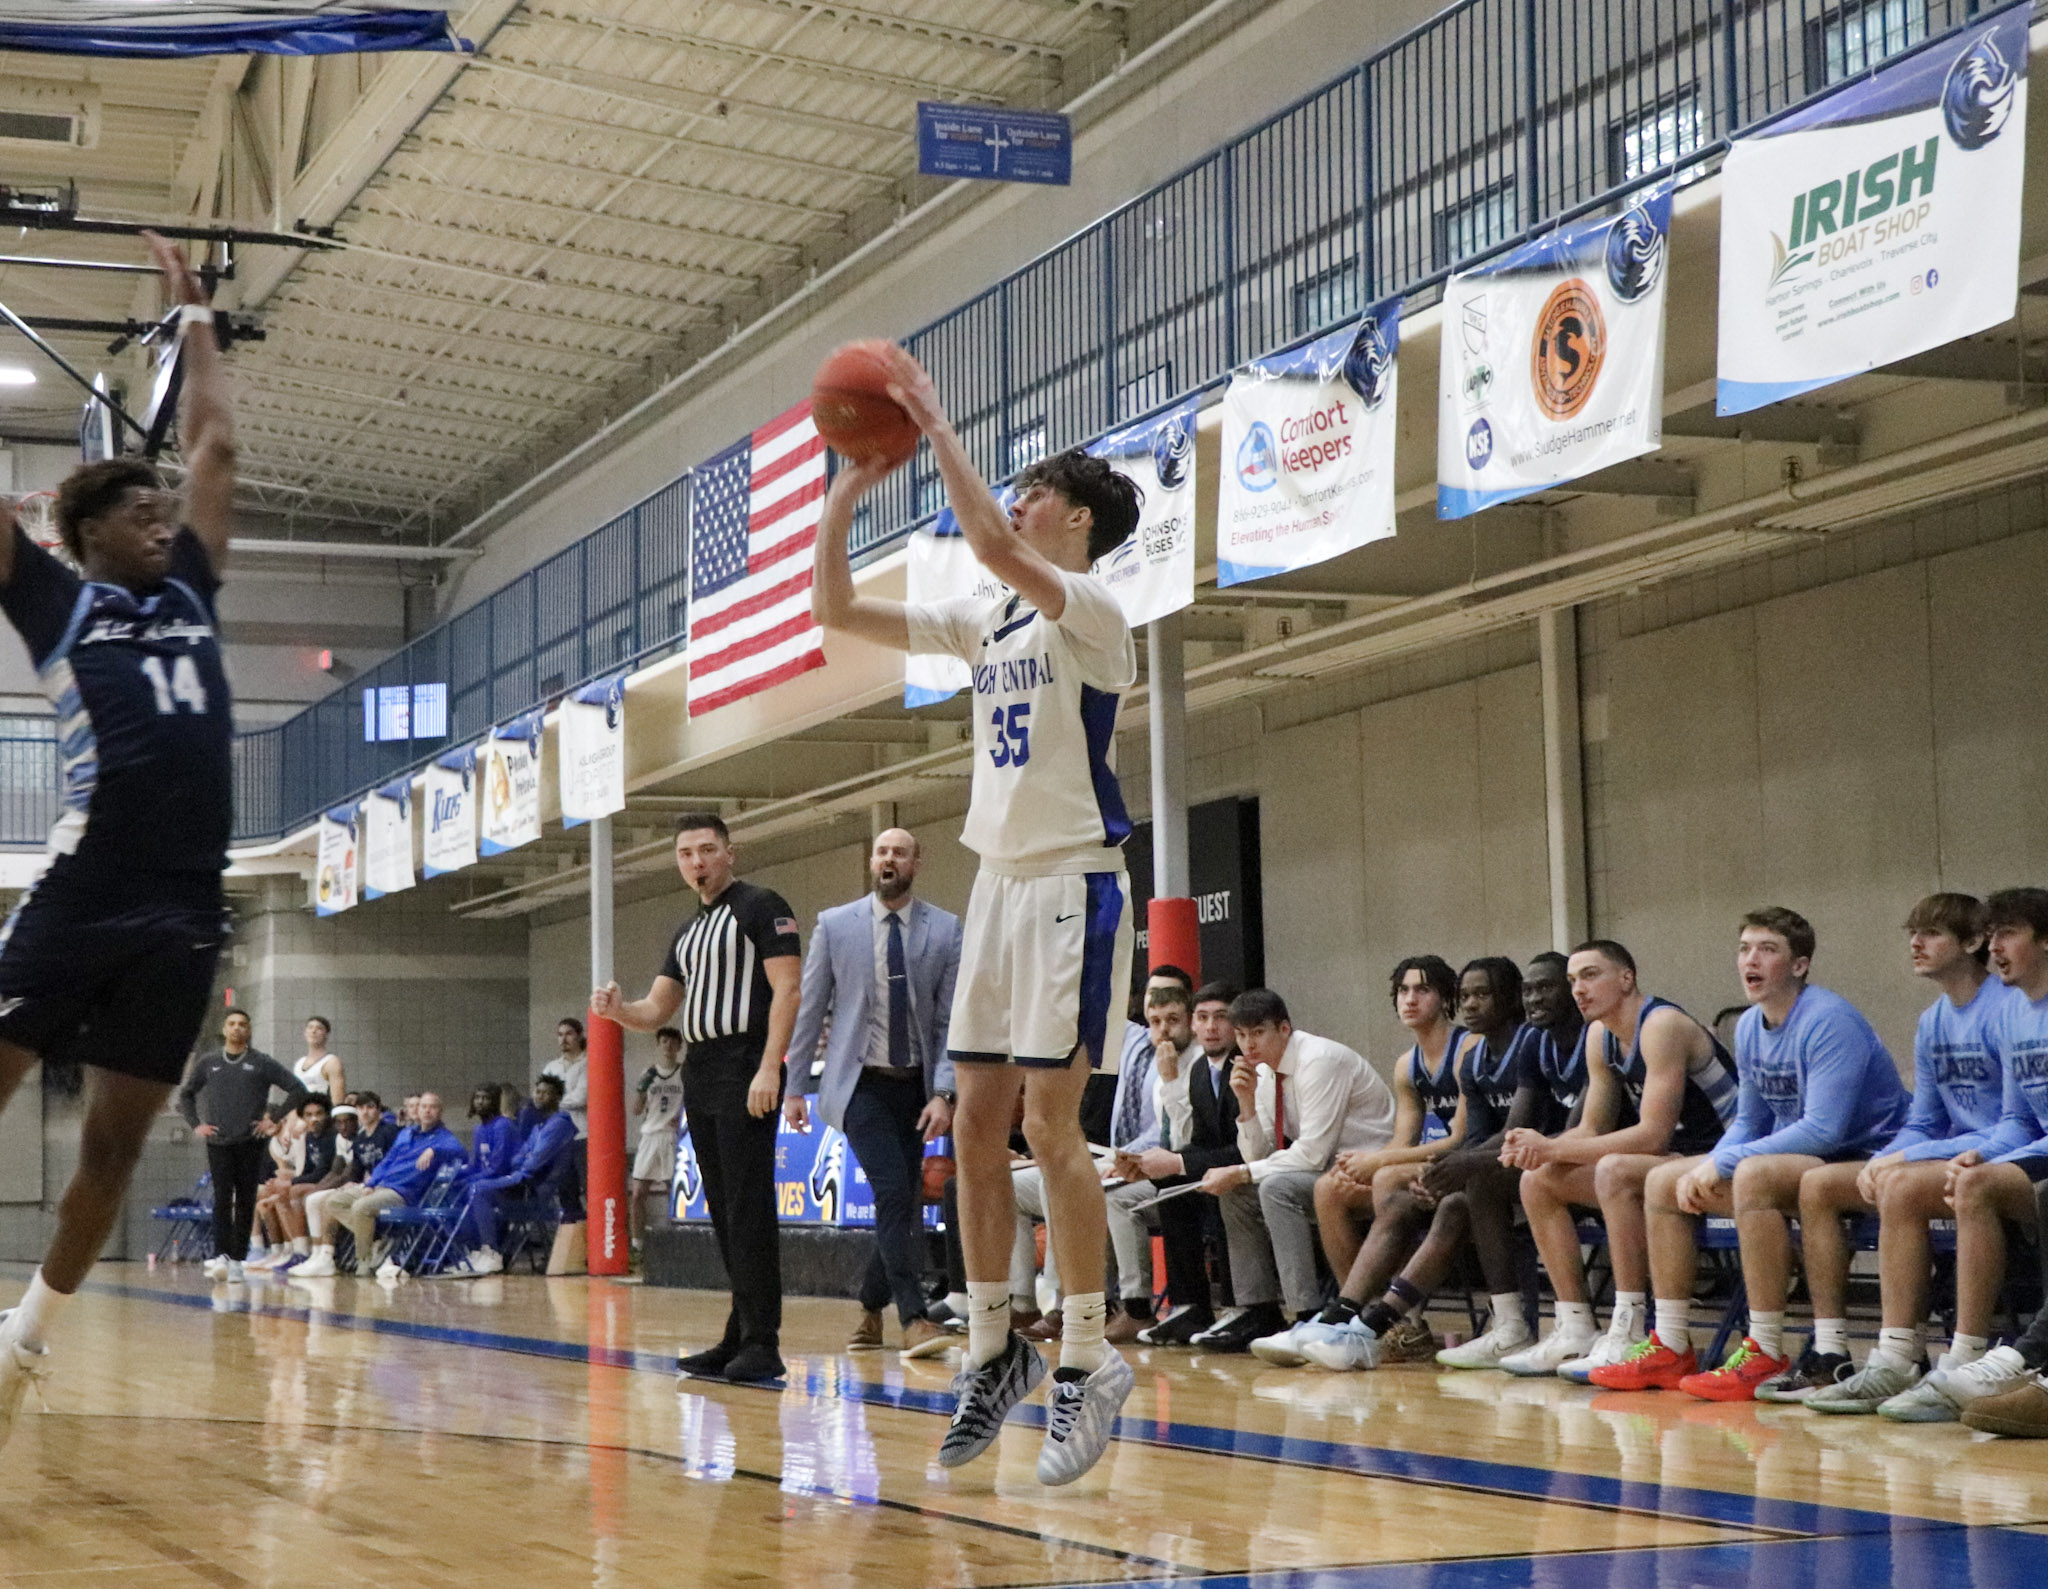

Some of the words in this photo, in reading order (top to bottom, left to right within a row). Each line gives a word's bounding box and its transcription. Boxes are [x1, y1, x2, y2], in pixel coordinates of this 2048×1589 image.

[1788, 135, 1940, 251] IRISH
[1817, 227, 1870, 268] BOAT
[1873, 202, 1931, 246] SHOP
[1792, 277, 1823, 297] Springs
[1881, 240, 1919, 260] Traverse
[1920, 232, 1938, 247] City
[1280, 400, 1348, 444] Comfort
[1468, 429, 1490, 459] NSF
[1281, 434, 1352, 474] Keepers
[1145, 536, 1174, 557] BUSES
[1231, 524, 1274, 546] Elevating
[1275, 521, 1290, 536] the
[1291, 515, 1322, 533] Human
[141, 655, 208, 715] 14
[989, 702, 1031, 768] 35
